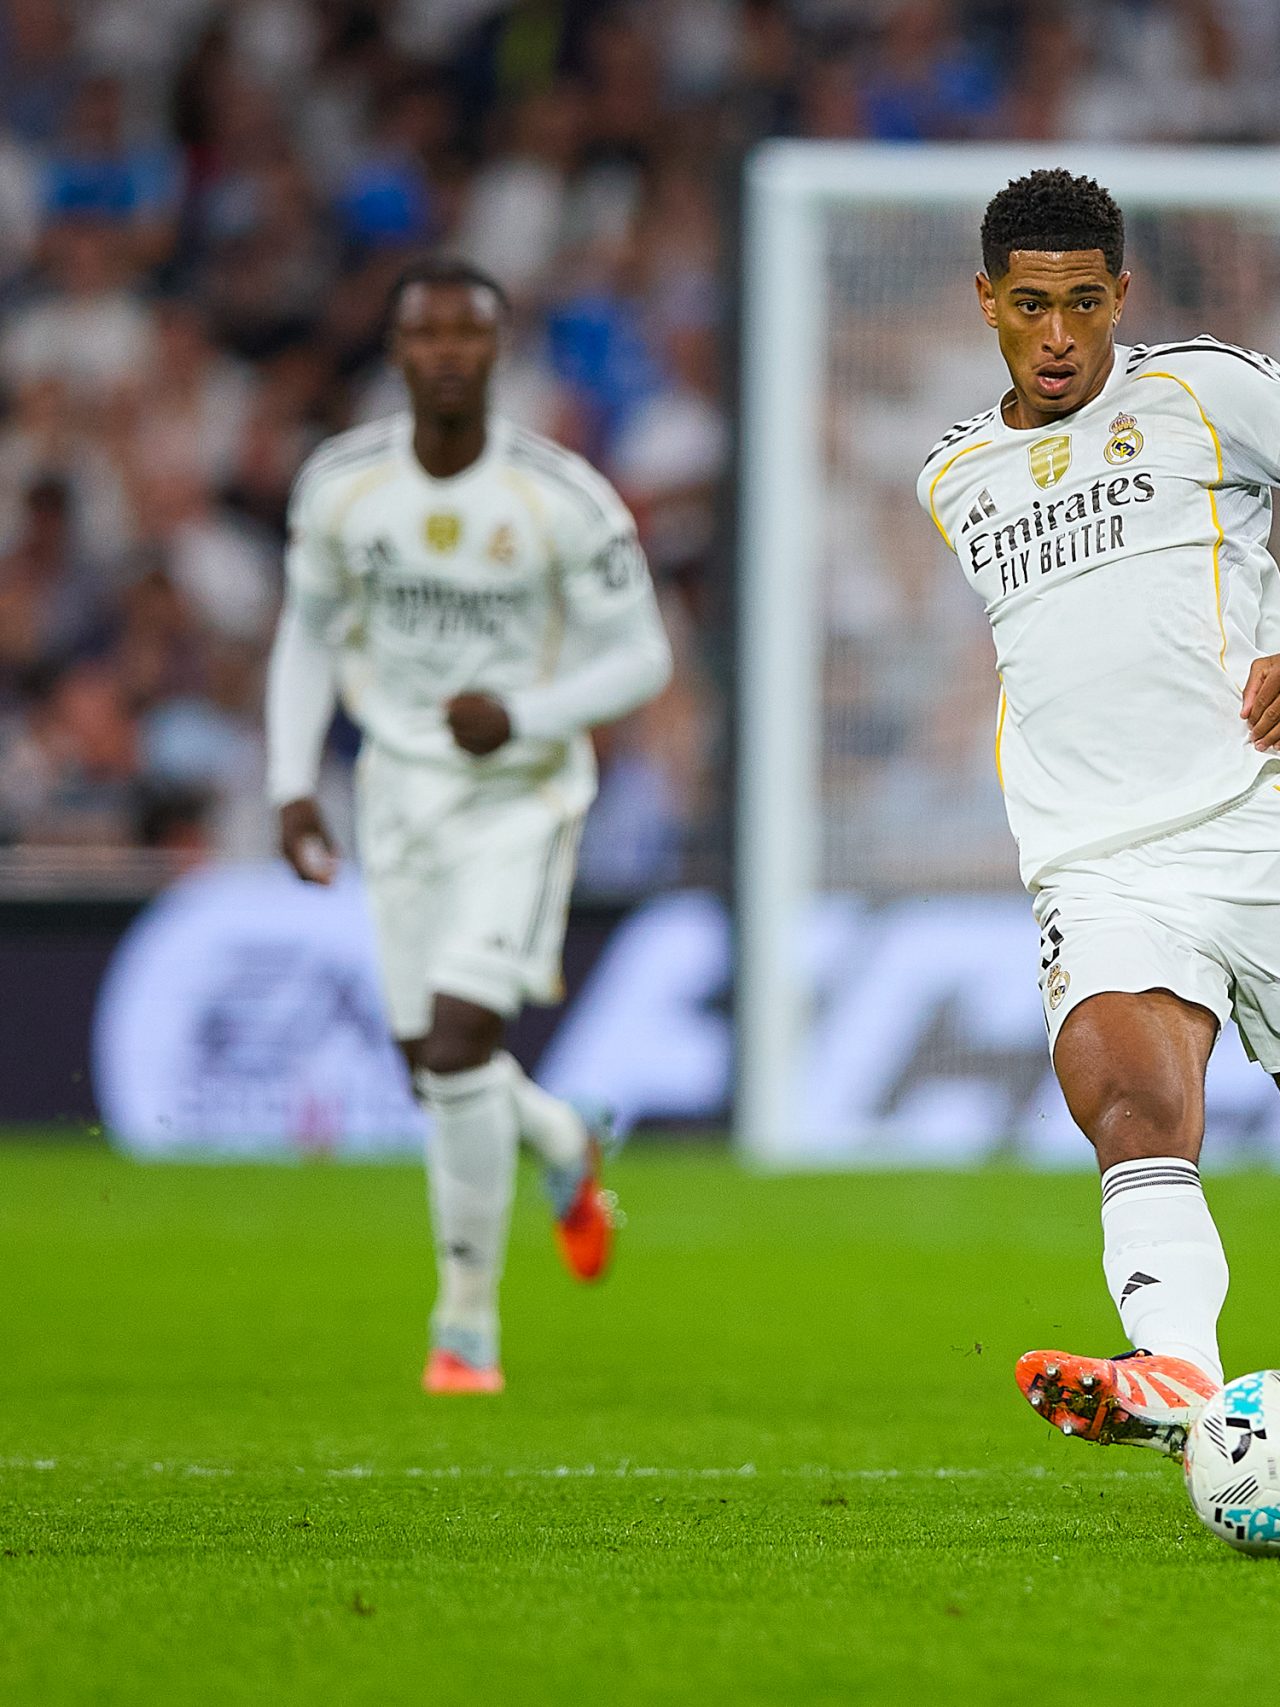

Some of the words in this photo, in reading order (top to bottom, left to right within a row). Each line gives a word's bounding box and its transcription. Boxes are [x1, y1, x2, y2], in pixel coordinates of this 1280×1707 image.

[969, 472, 1156, 574] Emirates
[1000, 550, 1031, 596] FLY
[1040, 513, 1126, 575] BETTER
